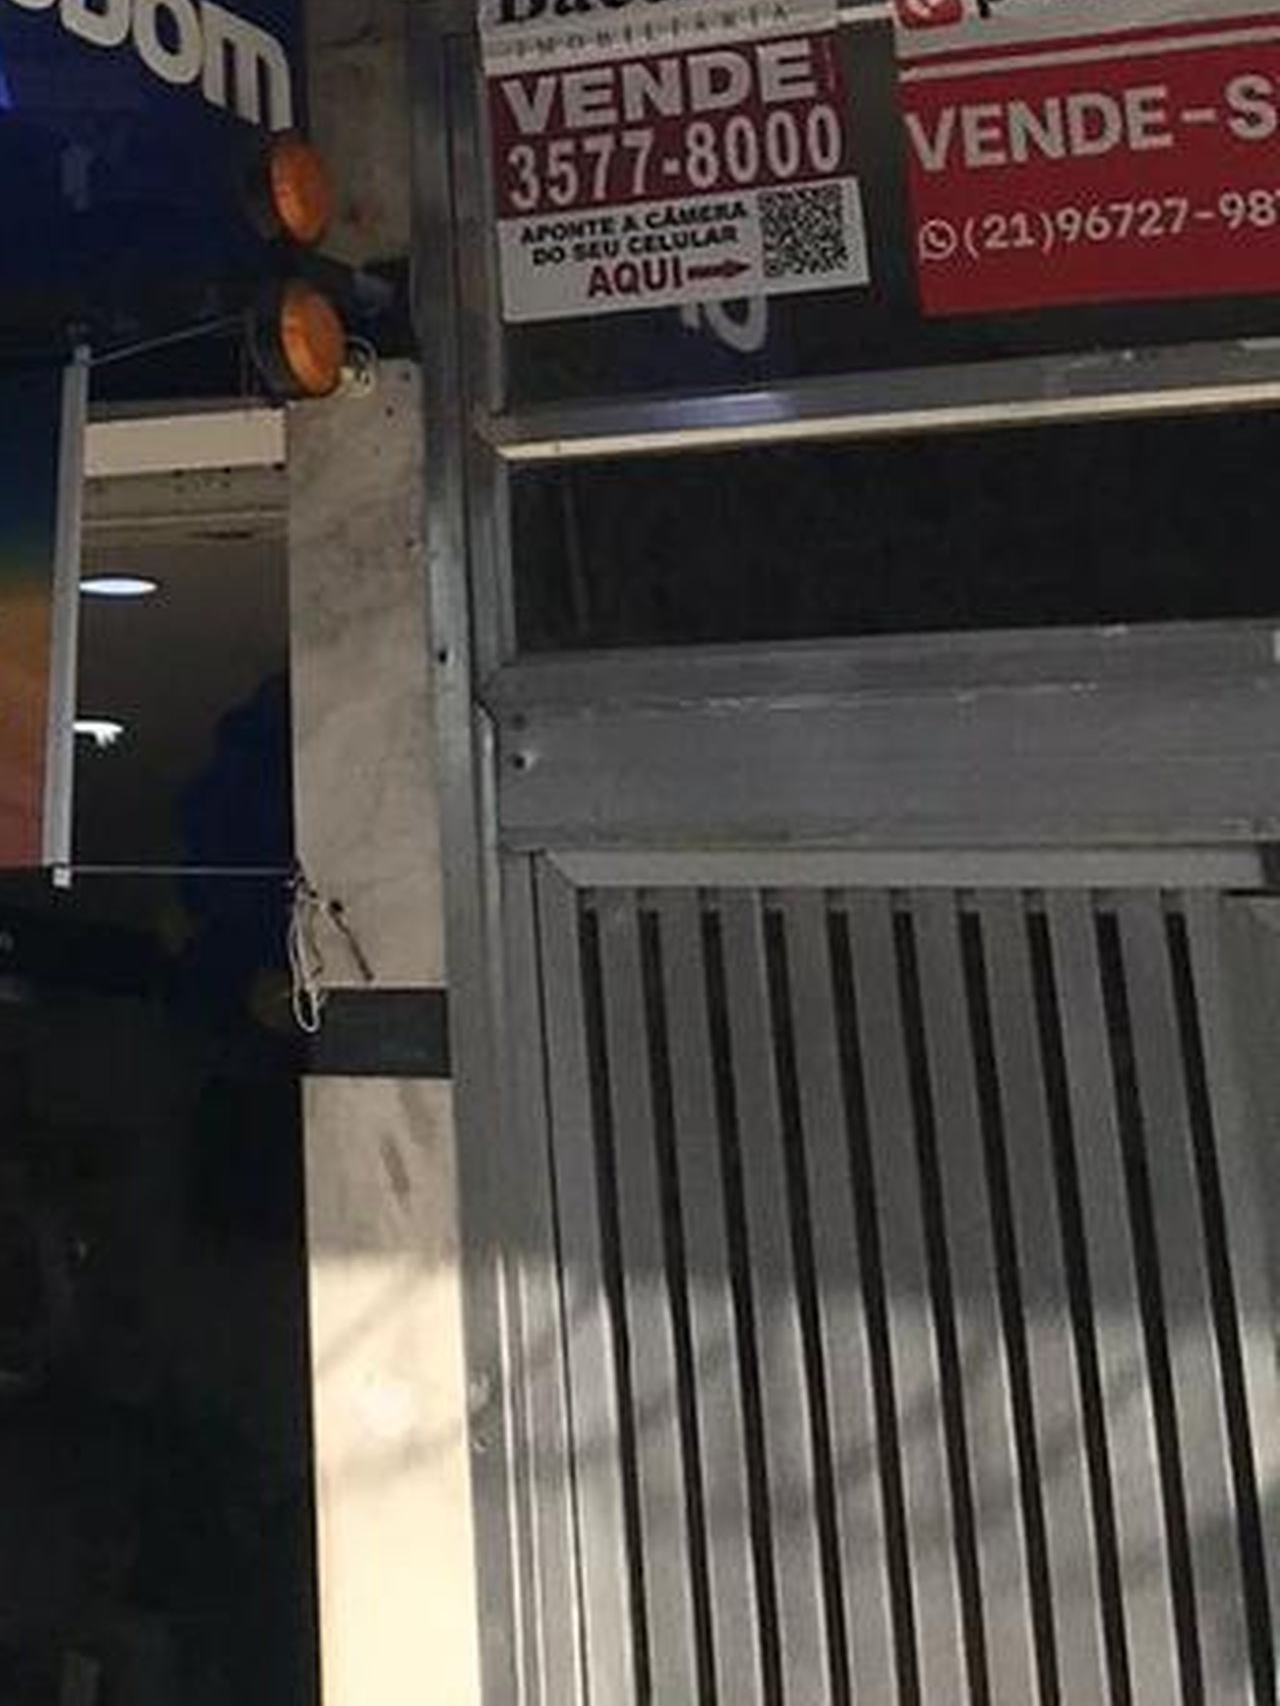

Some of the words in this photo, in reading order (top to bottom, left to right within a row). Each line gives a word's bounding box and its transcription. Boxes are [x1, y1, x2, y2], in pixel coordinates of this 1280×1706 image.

[502, 40, 817, 135] VENDE
[507, 105, 839, 210] 3577-8000
[905, 75, 1280, 172] VENDE-S
[521, 220, 618, 245] APONTE
[623, 217, 639, 233] A
[645, 202, 747, 230] CÂMERA
[533, 247, 566, 266] DO
[573, 238, 620, 259] SEU
[628, 227, 738, 254] CELULAR
[964, 190, 1280, 258] (21)96727-98
[587, 258, 683, 298] AQUI
